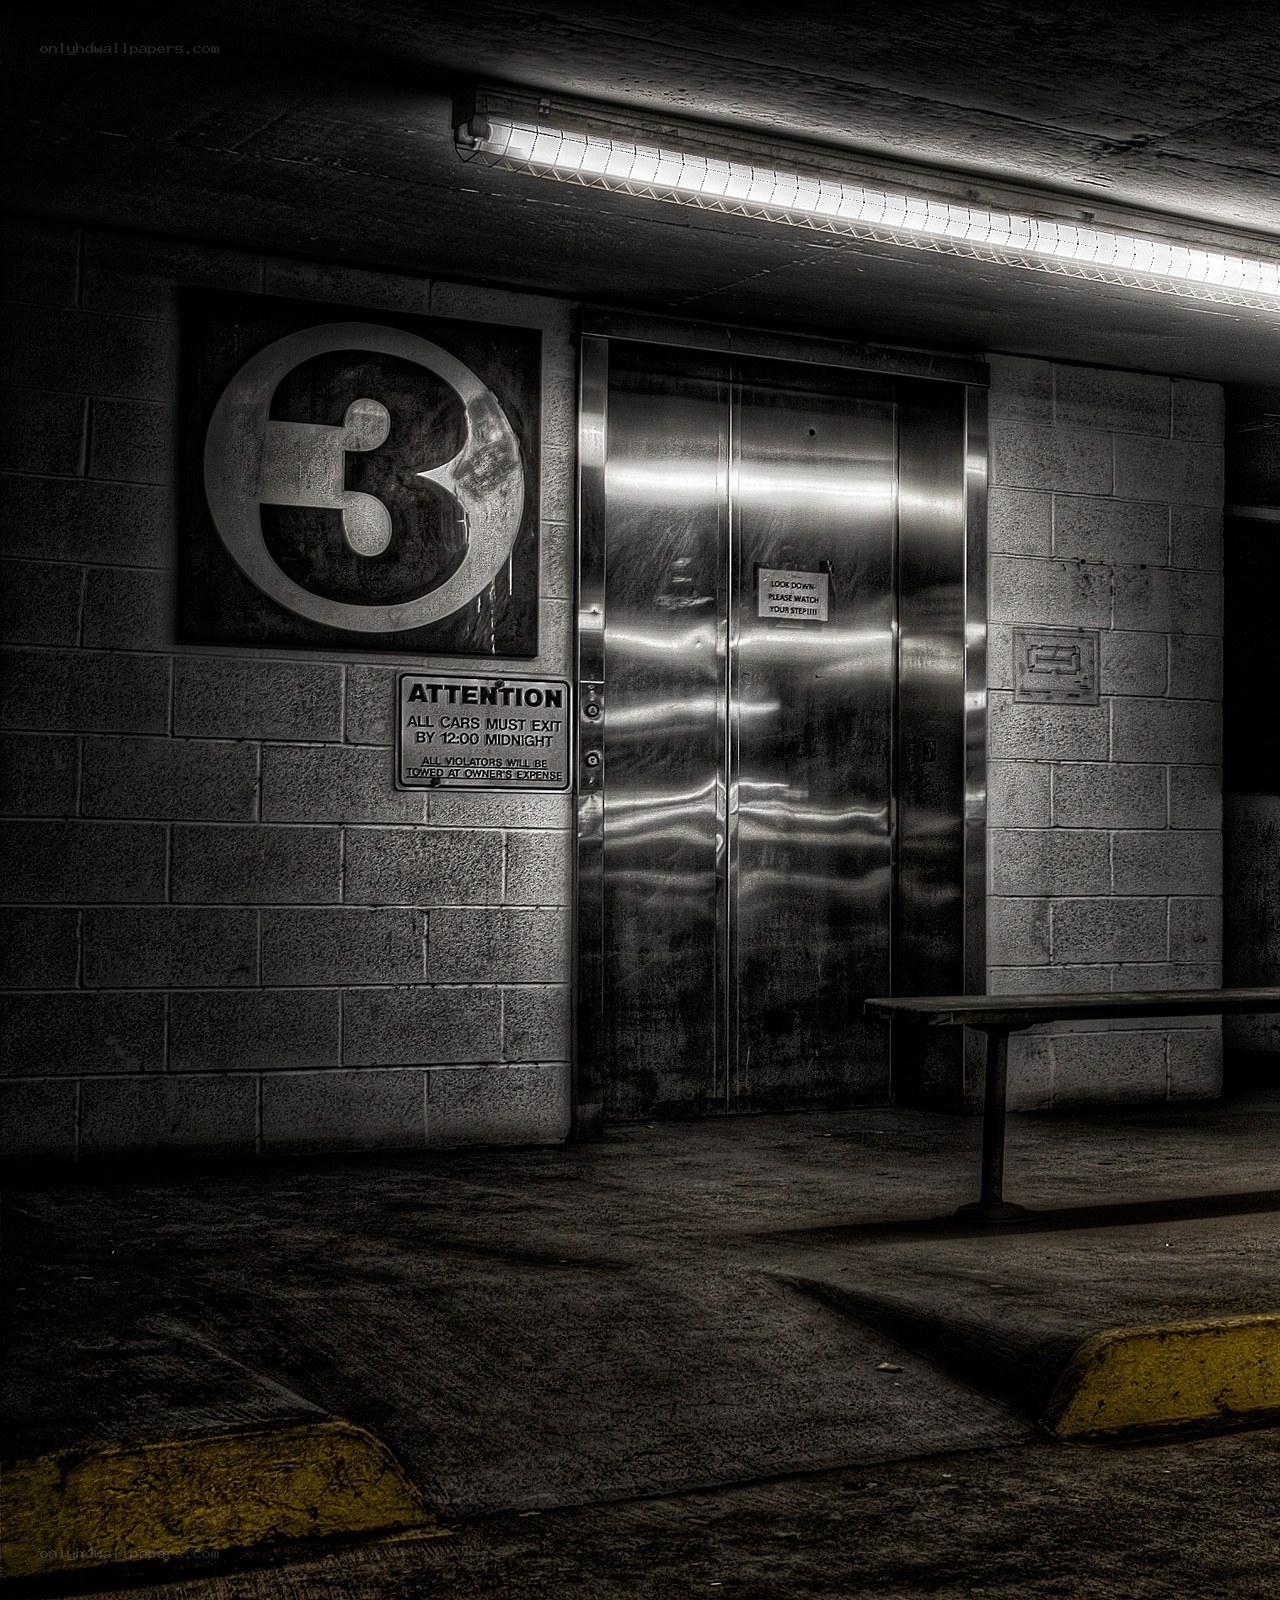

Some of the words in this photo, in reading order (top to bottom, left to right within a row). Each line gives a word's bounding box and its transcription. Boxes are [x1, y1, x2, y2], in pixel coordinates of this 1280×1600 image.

[260, 349, 471, 607] 3
[771, 580, 790, 589] LOOK
[768, 593, 792, 602] PLEASE
[793, 595, 819, 604] WATCH
[769, 605, 789, 614] YOUR
[408, 683, 563, 708] ATTENTION
[407, 715, 434, 728] ALL
[440, 716, 480, 730] CARS
[486, 718, 526, 731] MUST
[532, 720, 562, 732] EXIT
[416, 731, 436, 744] BY
[441, 732, 480, 745] 12:00
[485, 734, 553, 747] MIDNIGHT
[422, 756, 441, 766] ALL
[445, 757, 503, 767] VIOLATORS
[507, 758, 530, 768] WILL
[535, 759, 547, 768] BE
[407, 767, 443, 777] TOWED
[448, 768, 460, 778] AT
[464, 769, 512, 779] OWNER'S
[517, 770, 563, 780] EXPENSE
